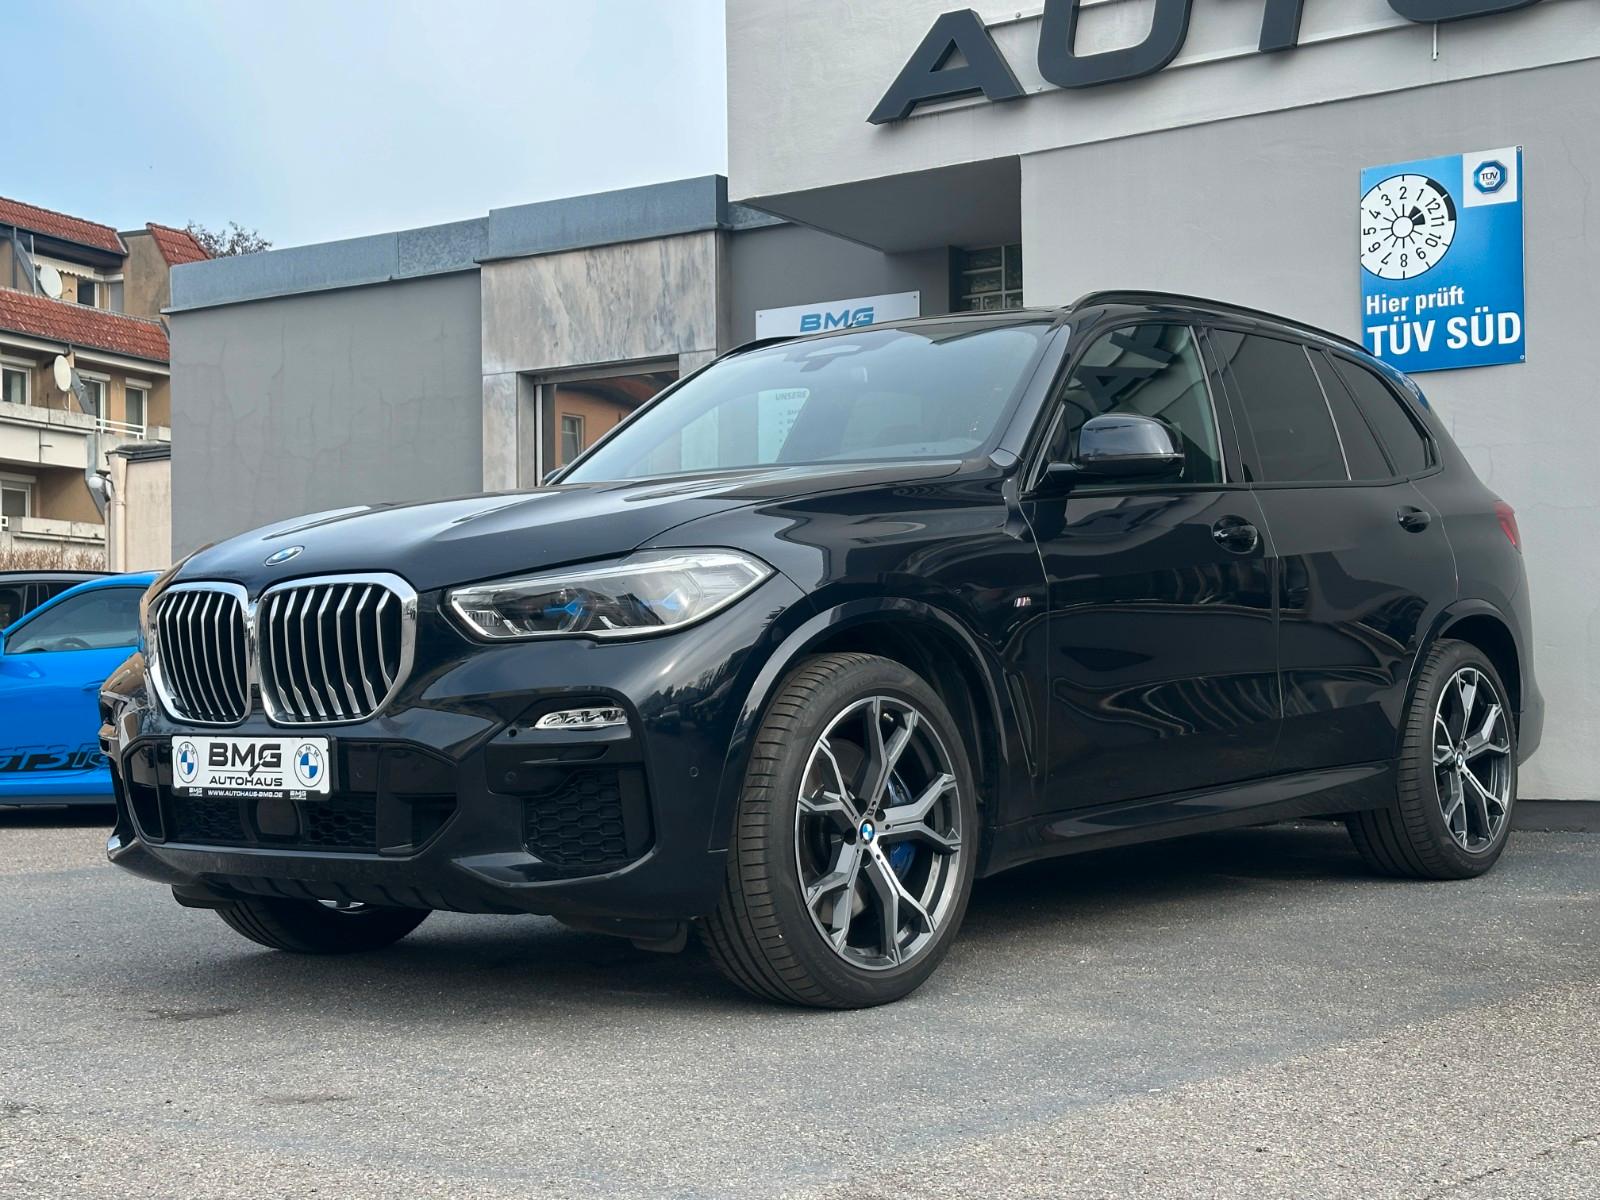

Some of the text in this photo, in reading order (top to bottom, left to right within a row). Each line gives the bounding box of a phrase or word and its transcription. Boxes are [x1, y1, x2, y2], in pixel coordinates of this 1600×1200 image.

[867, 0, 1542, 124] AU
[1399, 186, 1407, 200] 2
[1416, 188, 1425, 201] 1
[1380, 194, 1392, 206] 3
[1425, 197, 1441, 215] 12
[1368, 210, 1381, 219] 4
[1430, 214, 1445, 227] 11
[1363, 226, 1377, 236] 5
[1368, 241, 1381, 253] 6
[1425, 233, 1442, 248] 10
[1380, 252, 1392, 265] 7
[1415, 247, 1427, 260] 9
[1400, 253, 1408, 268] 8
[1366, 285, 1465, 316] Hier prüft
[800, 306, 875, 332] BMG
[1367, 305, 1521, 357] TÜV SÜD
[208, 742, 282, 768] BMG
[209, 776, 283, 787] AUTOHAUS
